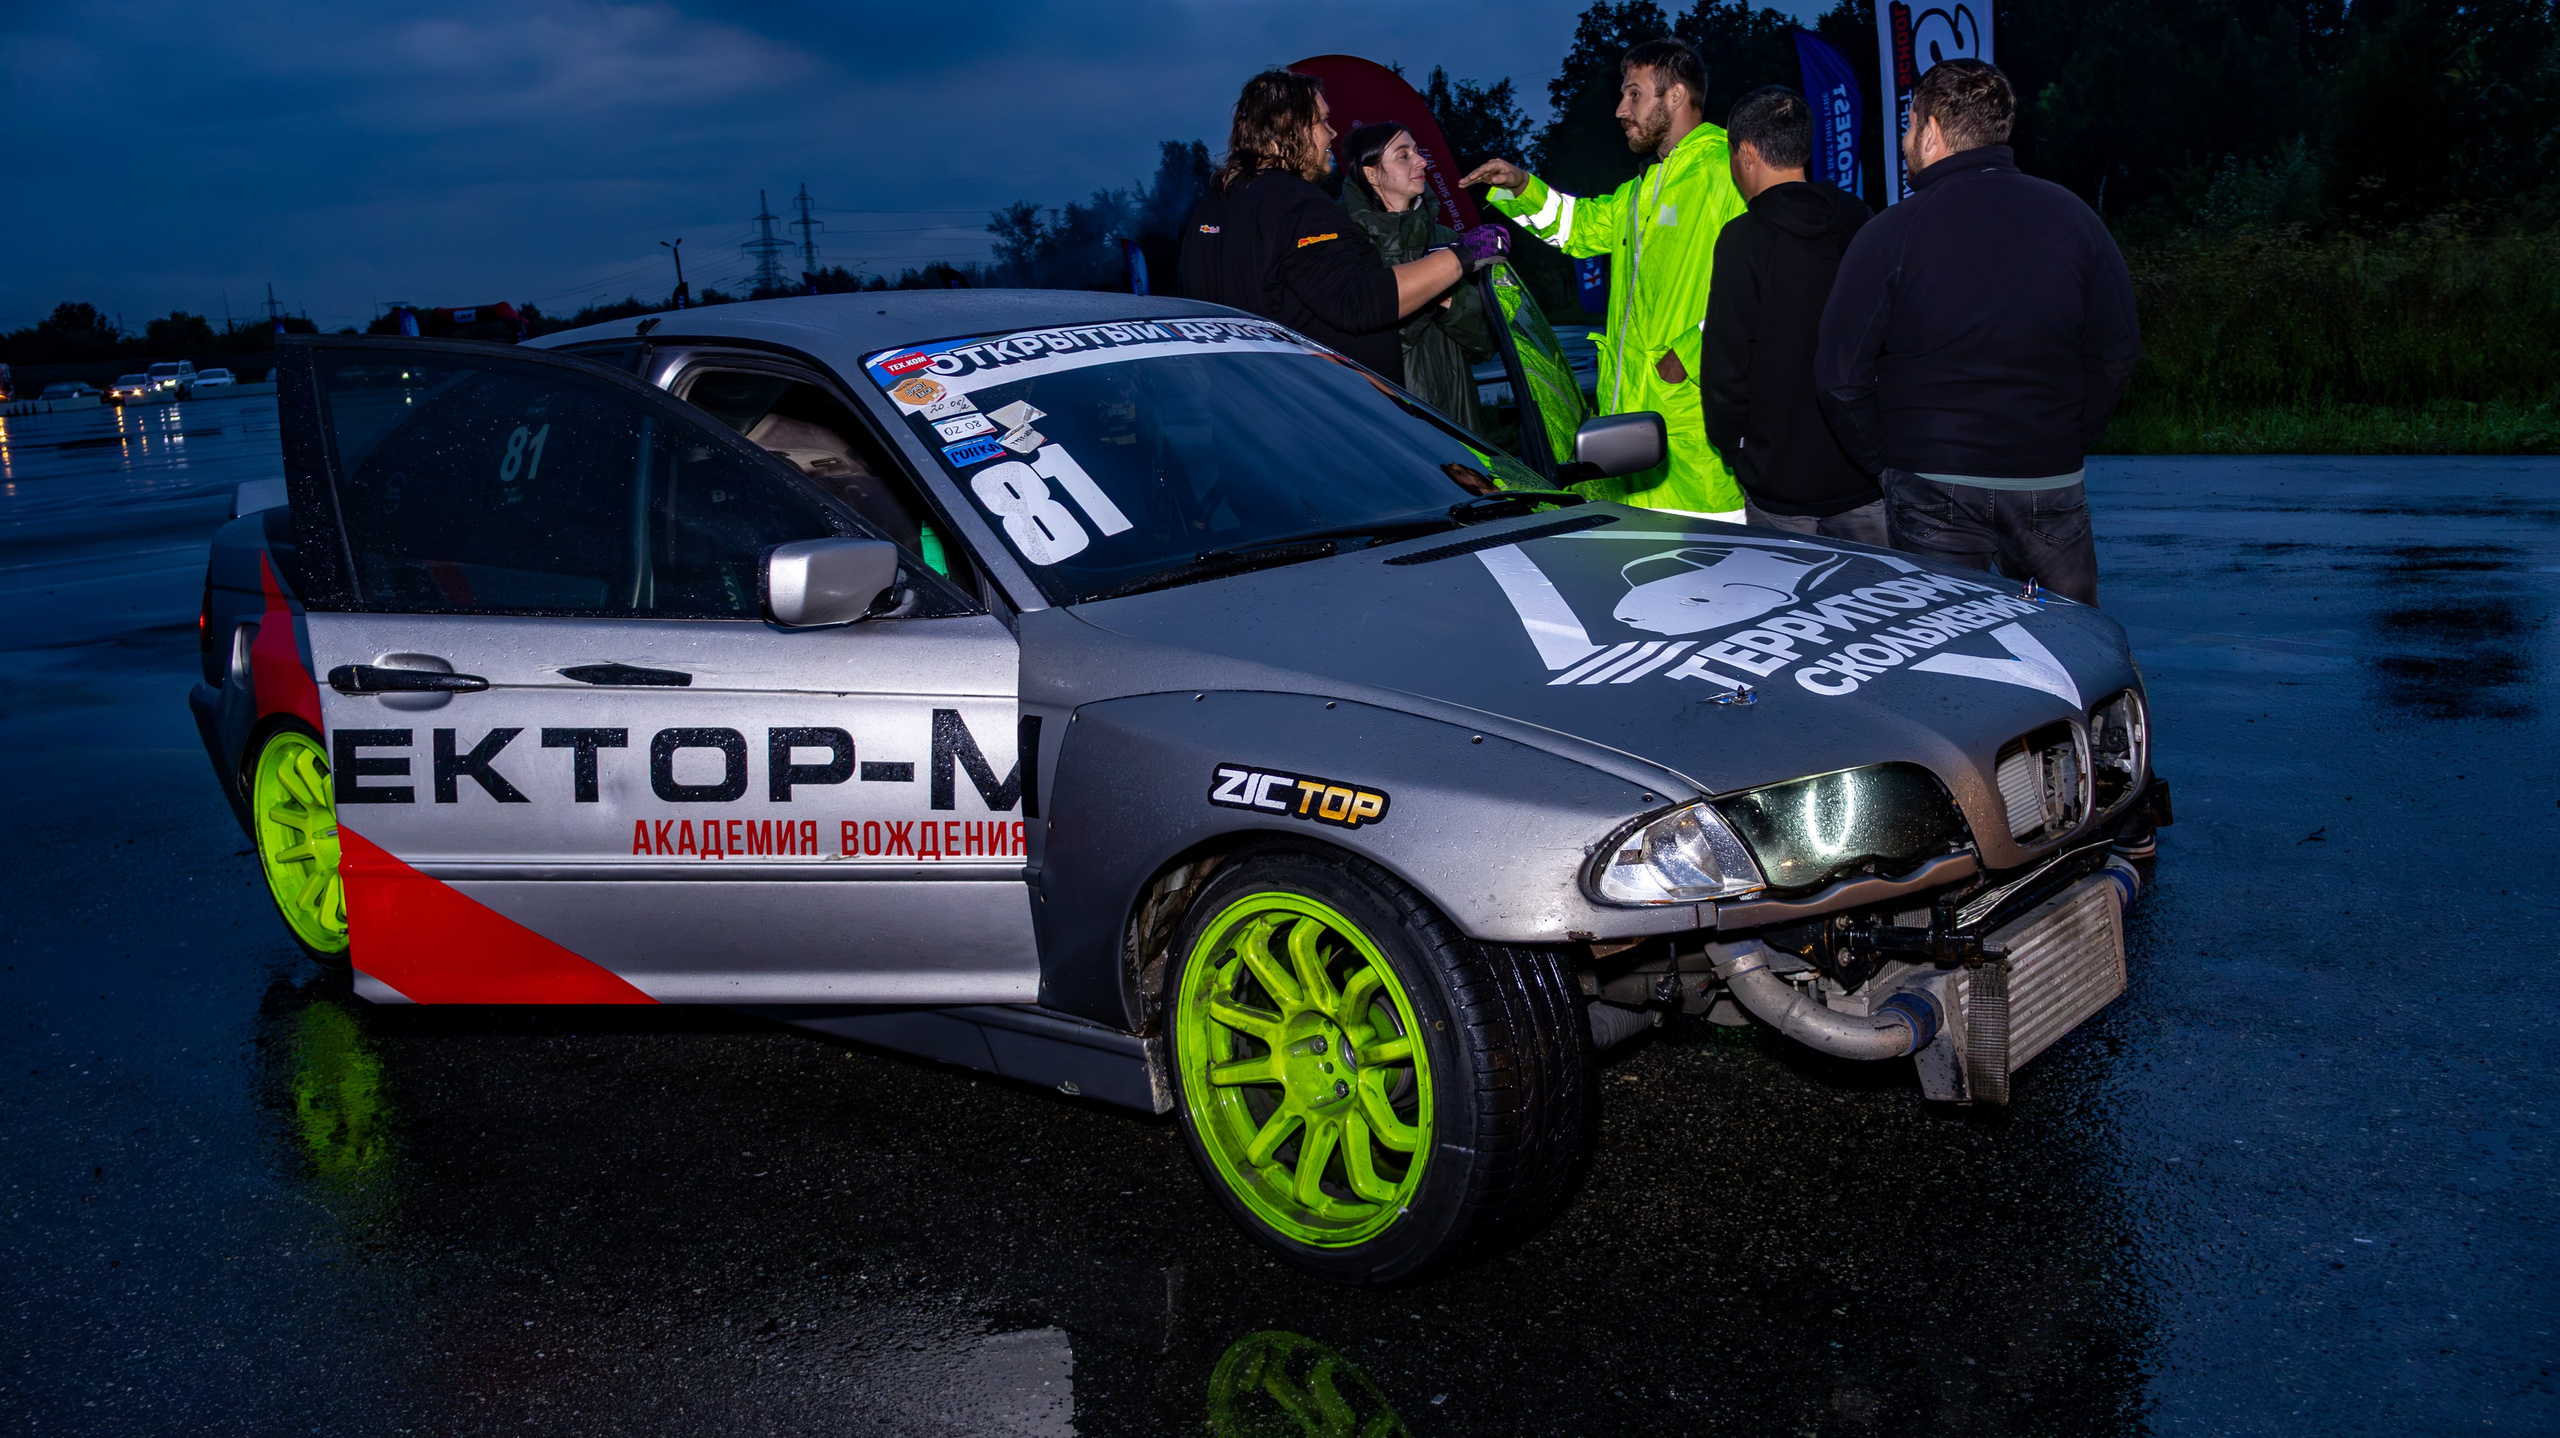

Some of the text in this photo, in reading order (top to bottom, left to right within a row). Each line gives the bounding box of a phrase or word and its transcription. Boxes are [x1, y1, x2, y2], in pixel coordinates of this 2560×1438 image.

[1423, 172, 1450, 198] since
[1443, 199, 1465, 231] Brand
[887, 356, 927, 372] ТЕХ.КОМ
[925, 320, 1168, 376] ОТКРЫТЫЙ
[500, 424, 550, 482] 81
[970, 443, 1133, 566] 81
[1794, 594, 2045, 696] СКОЛЬЖЕНИЯ
[1212, 768, 1384, 824] ZIC TOP
[632, 819, 1028, 860] АКАДЕМИЯ ВОЖДЕНИЯ
